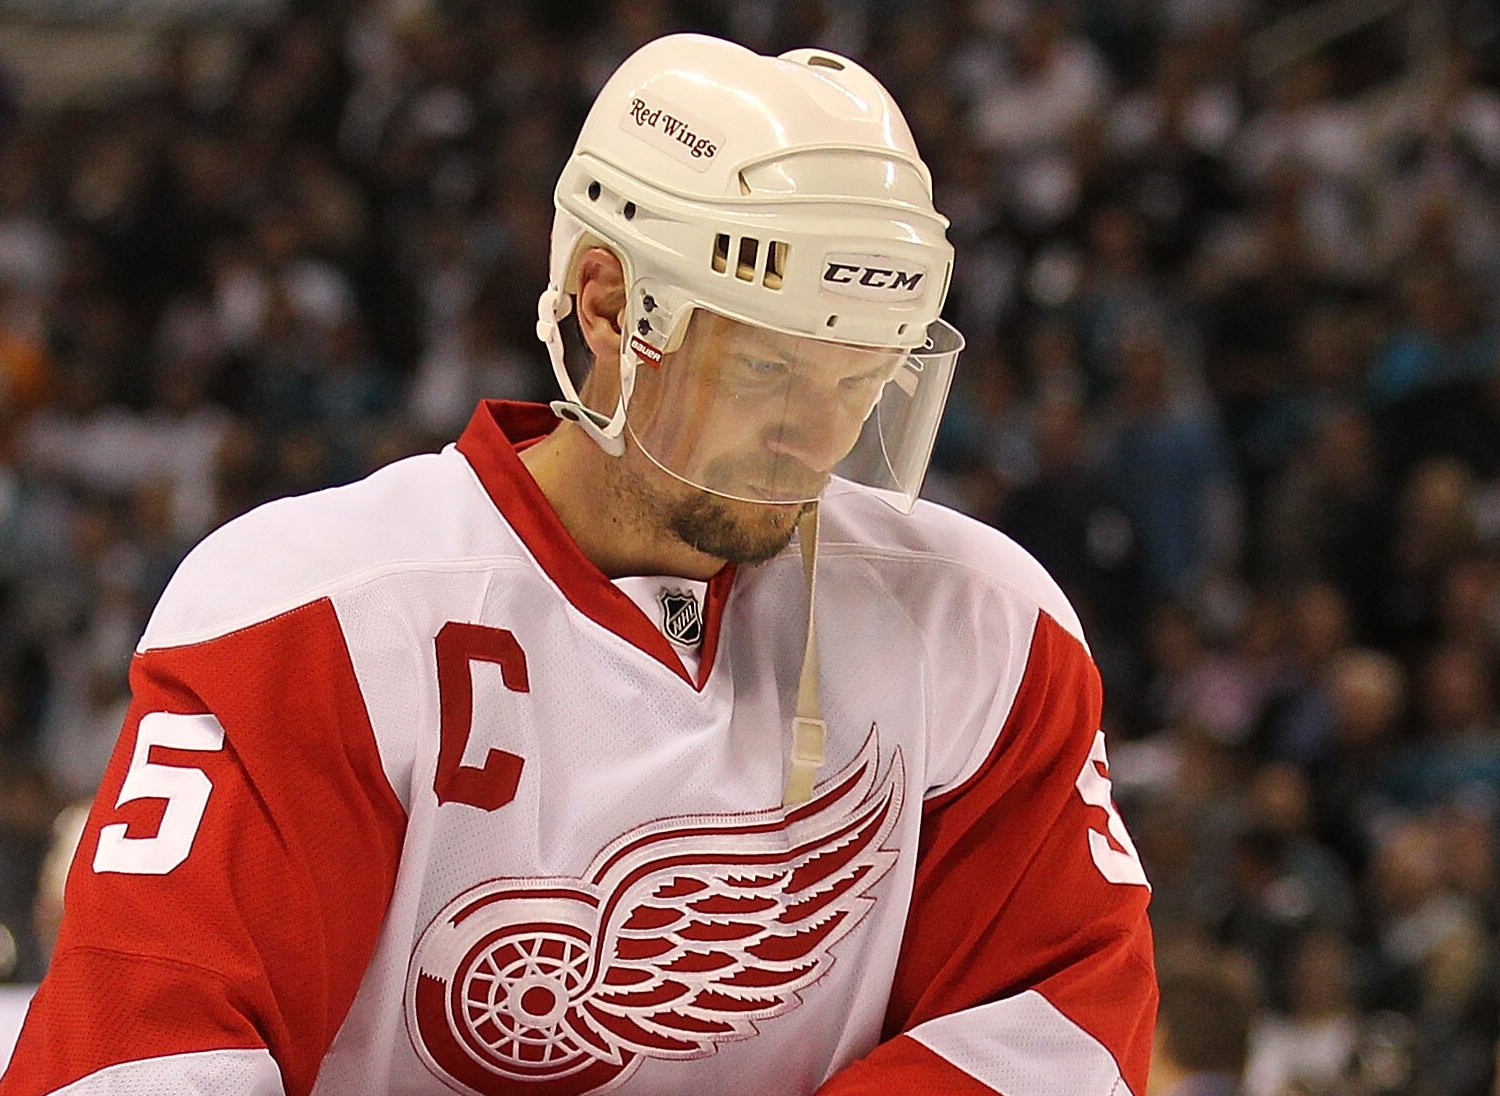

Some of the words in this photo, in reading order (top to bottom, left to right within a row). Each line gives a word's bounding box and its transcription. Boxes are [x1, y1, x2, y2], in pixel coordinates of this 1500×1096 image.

[630, 97, 663, 127] Red
[662, 114, 717, 158] Wings
[823, 263, 924, 291] CCM
[672, 604, 696, 635] NHL
[434, 621, 530, 812] C
[92, 711, 226, 875] 5
